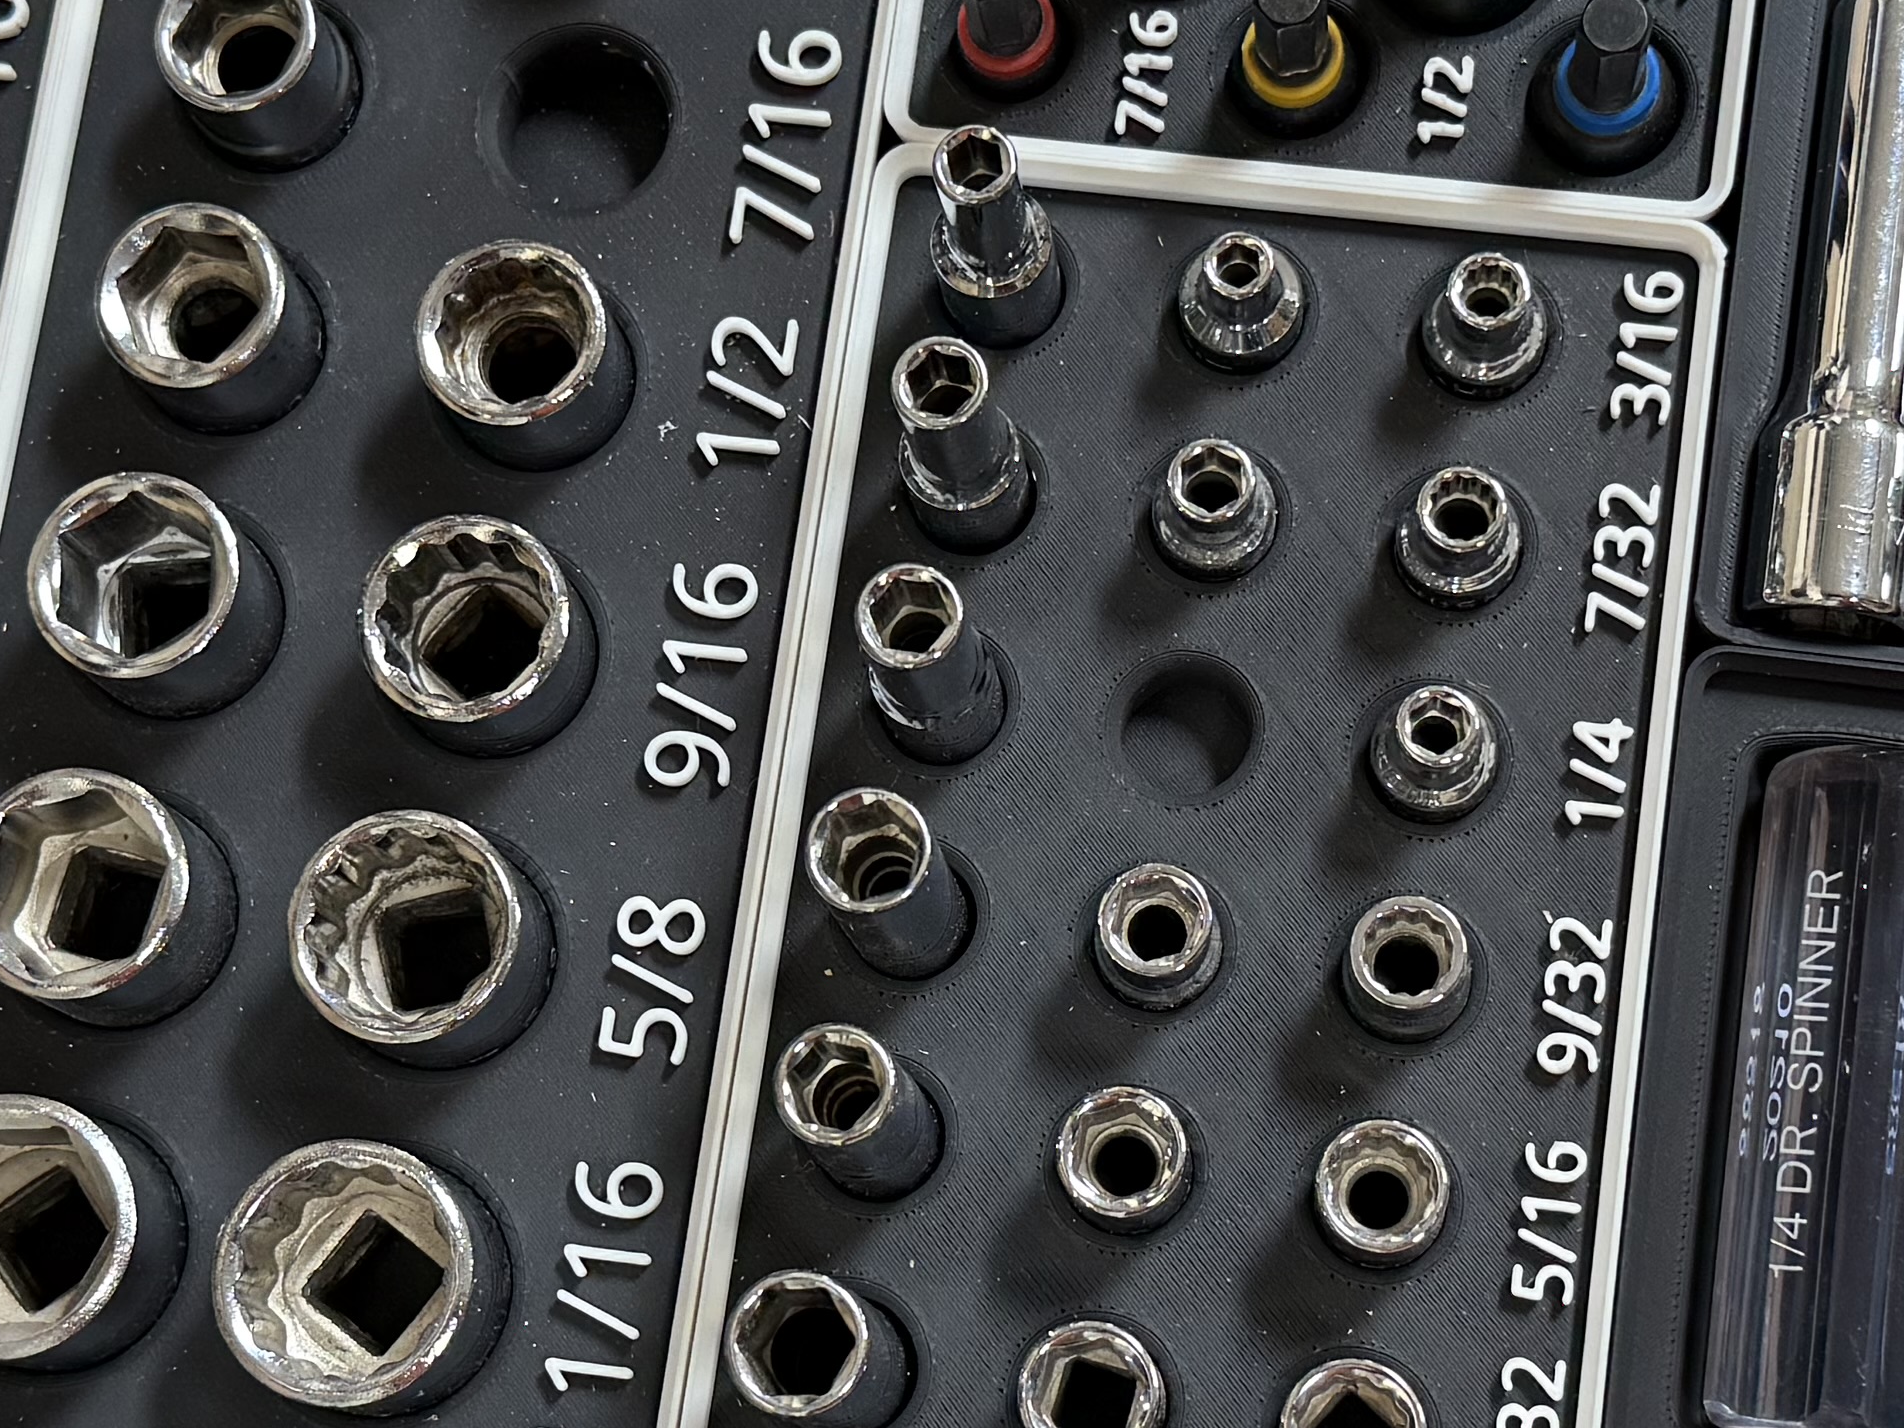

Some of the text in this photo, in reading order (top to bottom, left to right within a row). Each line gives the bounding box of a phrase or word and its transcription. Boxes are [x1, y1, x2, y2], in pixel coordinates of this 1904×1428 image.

[728, 29, 843, 244] 7/16
[1114, 9, 1179, 135] 7/16
[1416, 54, 1476, 144] 1/2
[695, 315, 800, 466] 1/2
[1609, 270, 1685, 426] 3/16
[1584, 477, 1662, 633] 7/32
[643, 562, 759, 787] 9/16
[1564, 717, 1635, 826] 1/4
[597, 895, 706, 1066] 5/8
[1536, 914, 1614, 1075] 9/32
[1770, 869, 1844, 1278] 1/4 DR. SPINNER
[1510, 1140, 1588, 1306] 5/16
